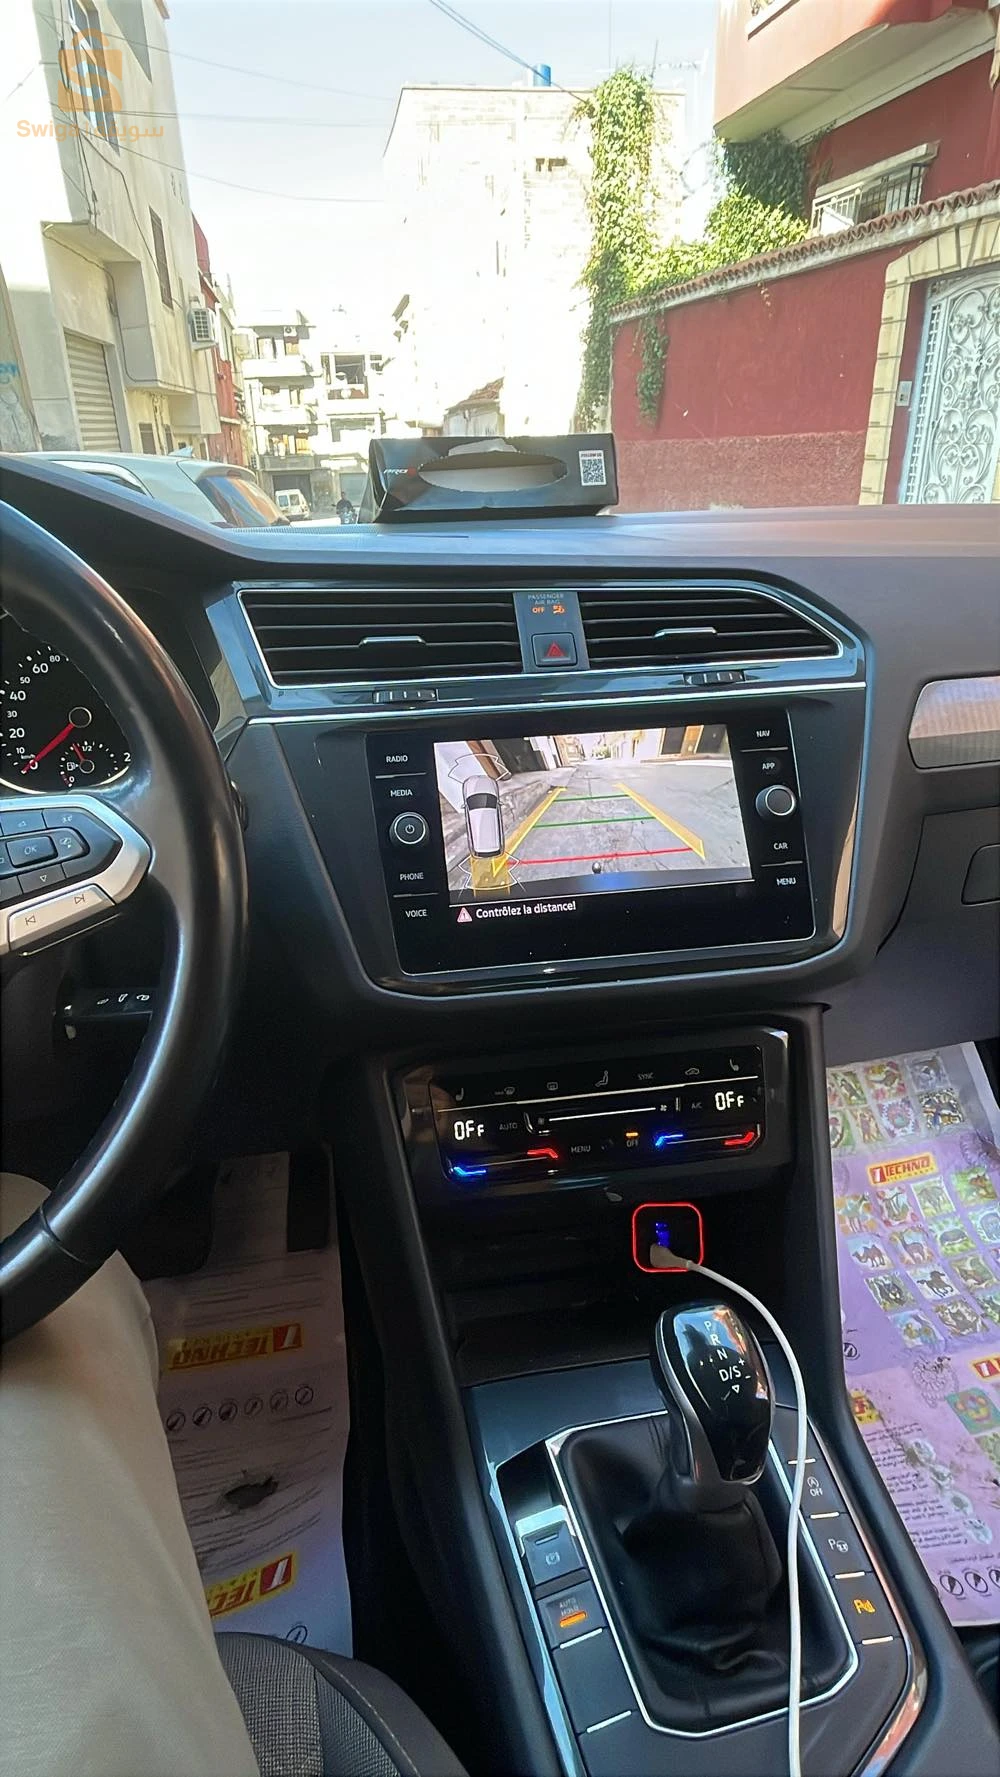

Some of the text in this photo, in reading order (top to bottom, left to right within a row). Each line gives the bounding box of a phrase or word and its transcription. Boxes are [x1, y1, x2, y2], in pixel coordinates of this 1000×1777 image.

[49, 655, 61, 663] 80
[32, 662, 49, 674] 60
[19, 676, 31, 685] 50
[9, 690, 26, 701] 40
[7, 710, 18, 718] 30
[9, 727, 25, 739] 20
[756, 730, 770, 738] NAV
[16, 746, 25, 755] 10
[386, 754, 408, 763] RADIO
[762, 762, 776, 770] APP
[68, 775, 75, 783] 0
[390, 788, 413, 797] MEDIA
[24, 845, 37, 855] OK
[773, 842, 788, 850] CAR
[399, 872, 424, 881] PHONE
[776, 877, 796, 886] MENU
[405, 909, 427, 918] VOICE
[476, 904, 522, 919] Contrôlez
[523, 904, 532, 915] la
[638, 1072, 654, 1080] SYNC
[691, 1102, 702, 1110] A/C
[499, 1122, 518, 1131] AUTO
[626, 1140, 639, 1148] OFF
[570, 1145, 591, 1153] MENU
[884, 1156, 930, 1176] TECHNO
[704, 1320, 712, 1331] P
[711, 1333, 720, 1346] R
[716, 1349, 728, 1361] N
[719, 1365, 741, 1382] D/S
